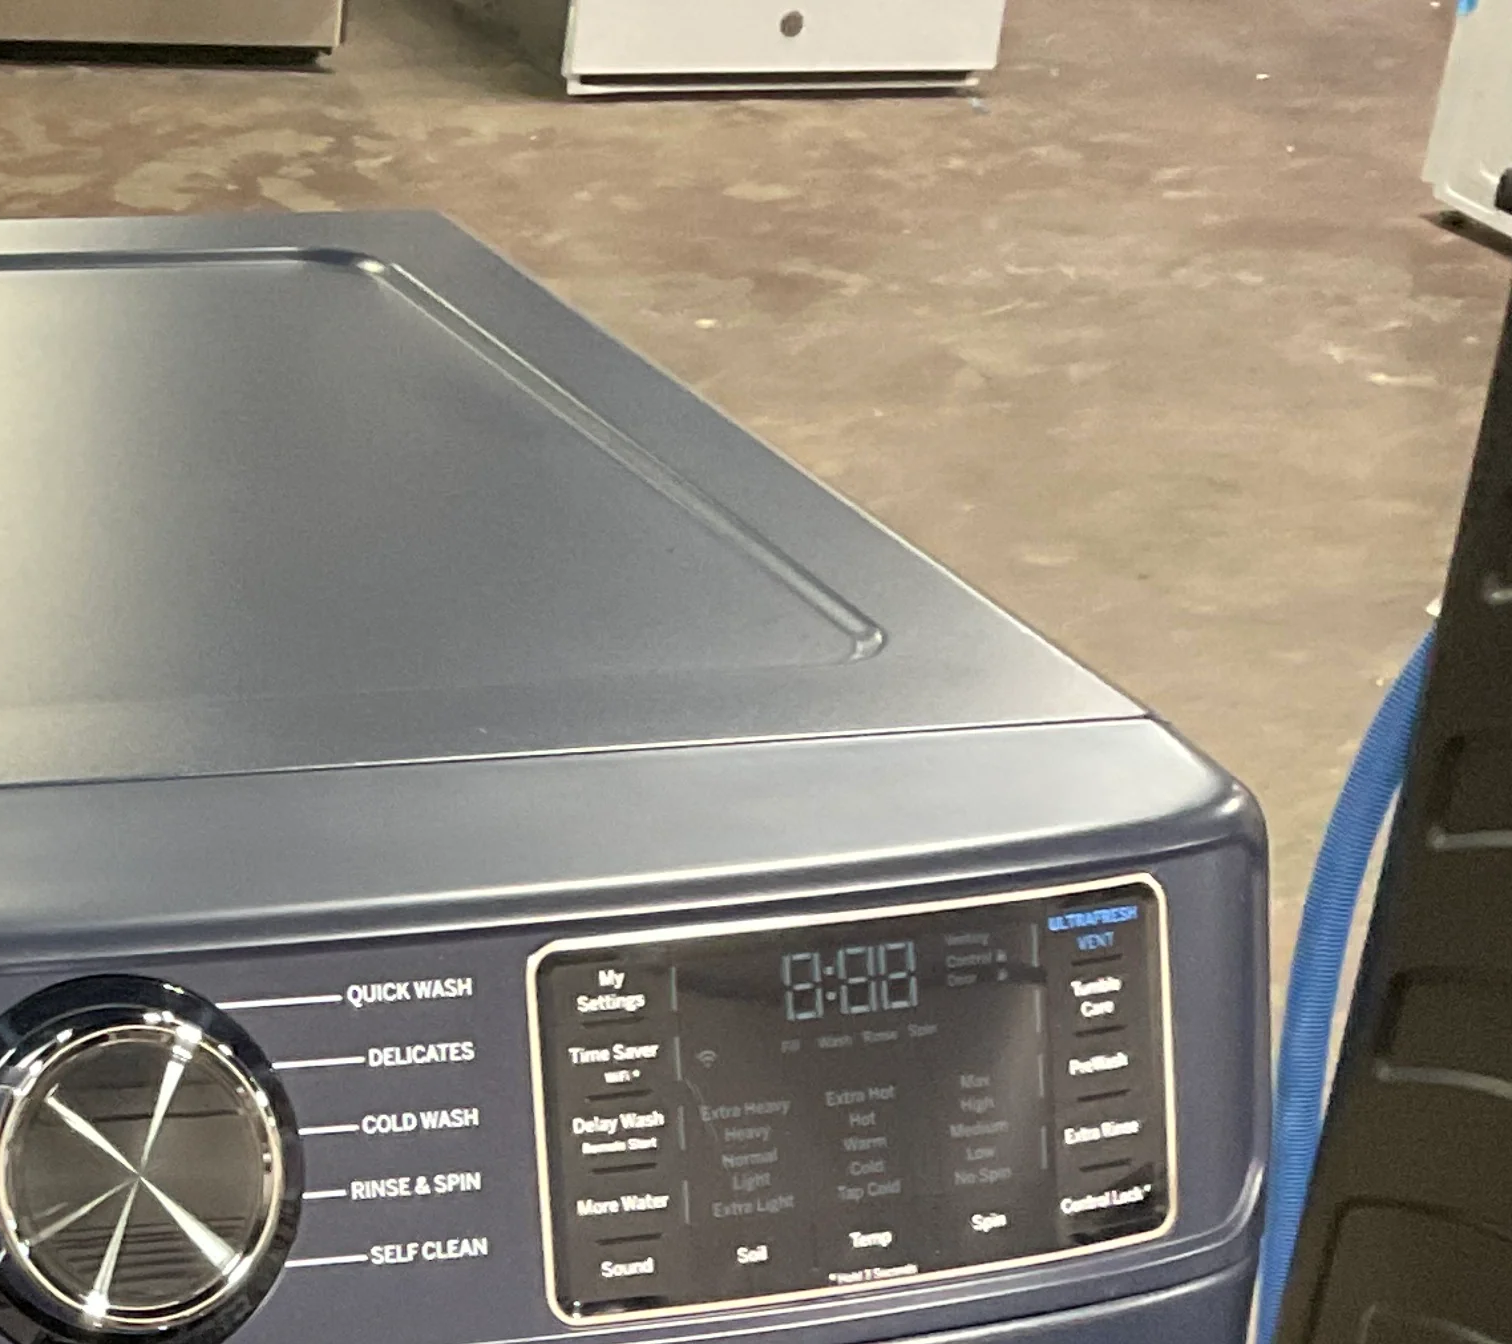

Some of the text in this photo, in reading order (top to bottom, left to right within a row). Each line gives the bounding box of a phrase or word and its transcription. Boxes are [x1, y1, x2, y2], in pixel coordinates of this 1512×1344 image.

[1048, 905, 1138, 932] ULTRAFRESH
[598, 969, 625, 990] My
[346, 977, 473, 1009] QUICK WASH
[577, 993, 645, 1013] Settings
[368, 1041, 475, 1068] DELICATES
[568, 1043, 659, 1064] Time Saver
[826, 1085, 896, 1107] Extra Hot
[361, 1107, 480, 1135] COLD WASH
[699, 1100, 792, 1122] Extra Heavy
[849, 1111, 877, 1127] Hot
[572, 1111, 666, 1135] Delay Wash
[849, 1159, 885, 1177] Cold
[350, 1171, 482, 1200] RINSE & SPIN
[576, 1193, 669, 1217] More Water
[971, 1212, 1007, 1232] Spin
[370, 1237, 488, 1266] SELF CLEAN
[600, 1257, 656, 1279] Sound
